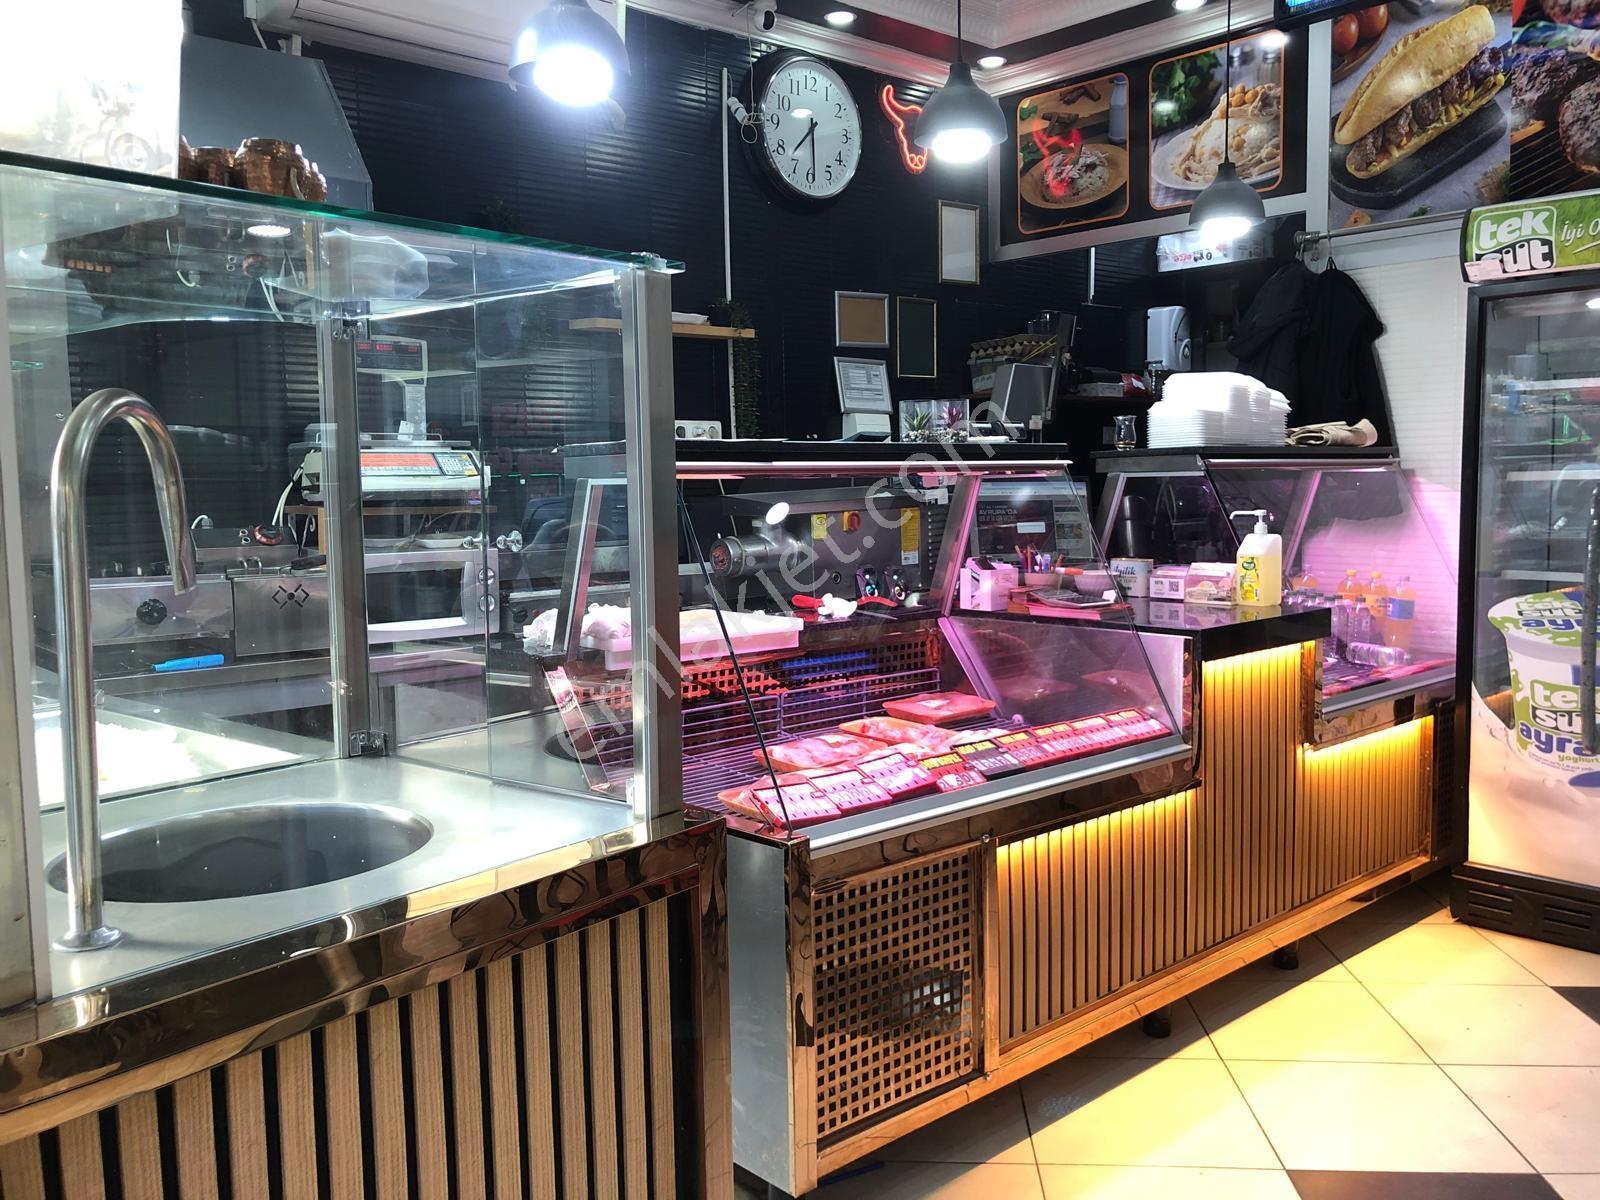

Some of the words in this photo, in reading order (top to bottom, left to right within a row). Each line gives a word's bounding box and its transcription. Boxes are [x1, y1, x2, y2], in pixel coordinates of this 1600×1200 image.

[789, 78, 800, 95] 11
[804, 74, 817, 92] 12
[776, 94, 791, 111] 10
[834, 103, 842, 118] 2
[770, 113, 780, 130] 9
[841, 129, 849, 144] 3
[776, 138, 786, 155] 8
[791, 158, 799, 174] 7
[834, 150, 843, 166] 4
[806, 167, 816, 184] 6
[824, 165, 832, 181] 5
[1480, 211, 1550, 249] tek
